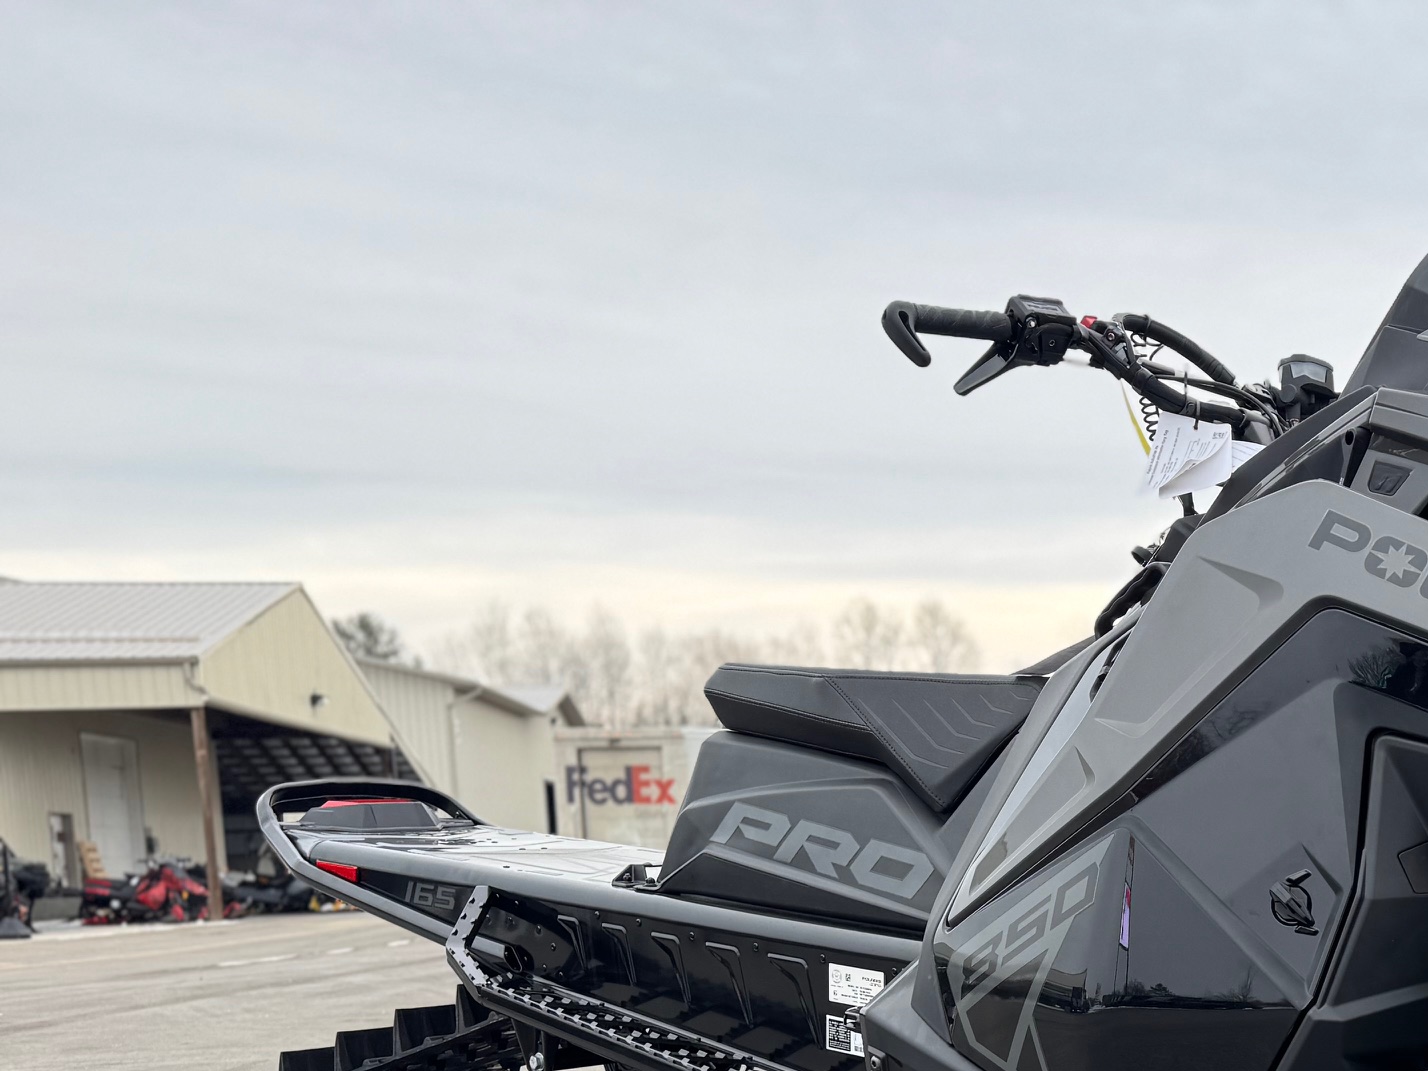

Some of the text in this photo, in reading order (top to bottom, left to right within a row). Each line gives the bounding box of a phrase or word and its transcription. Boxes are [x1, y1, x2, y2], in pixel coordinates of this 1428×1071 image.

[566, 766, 676, 806] FedEx
[709, 801, 935, 900] PRO
[405, 881, 456, 910] 165
[962, 862, 1099, 984] 850
